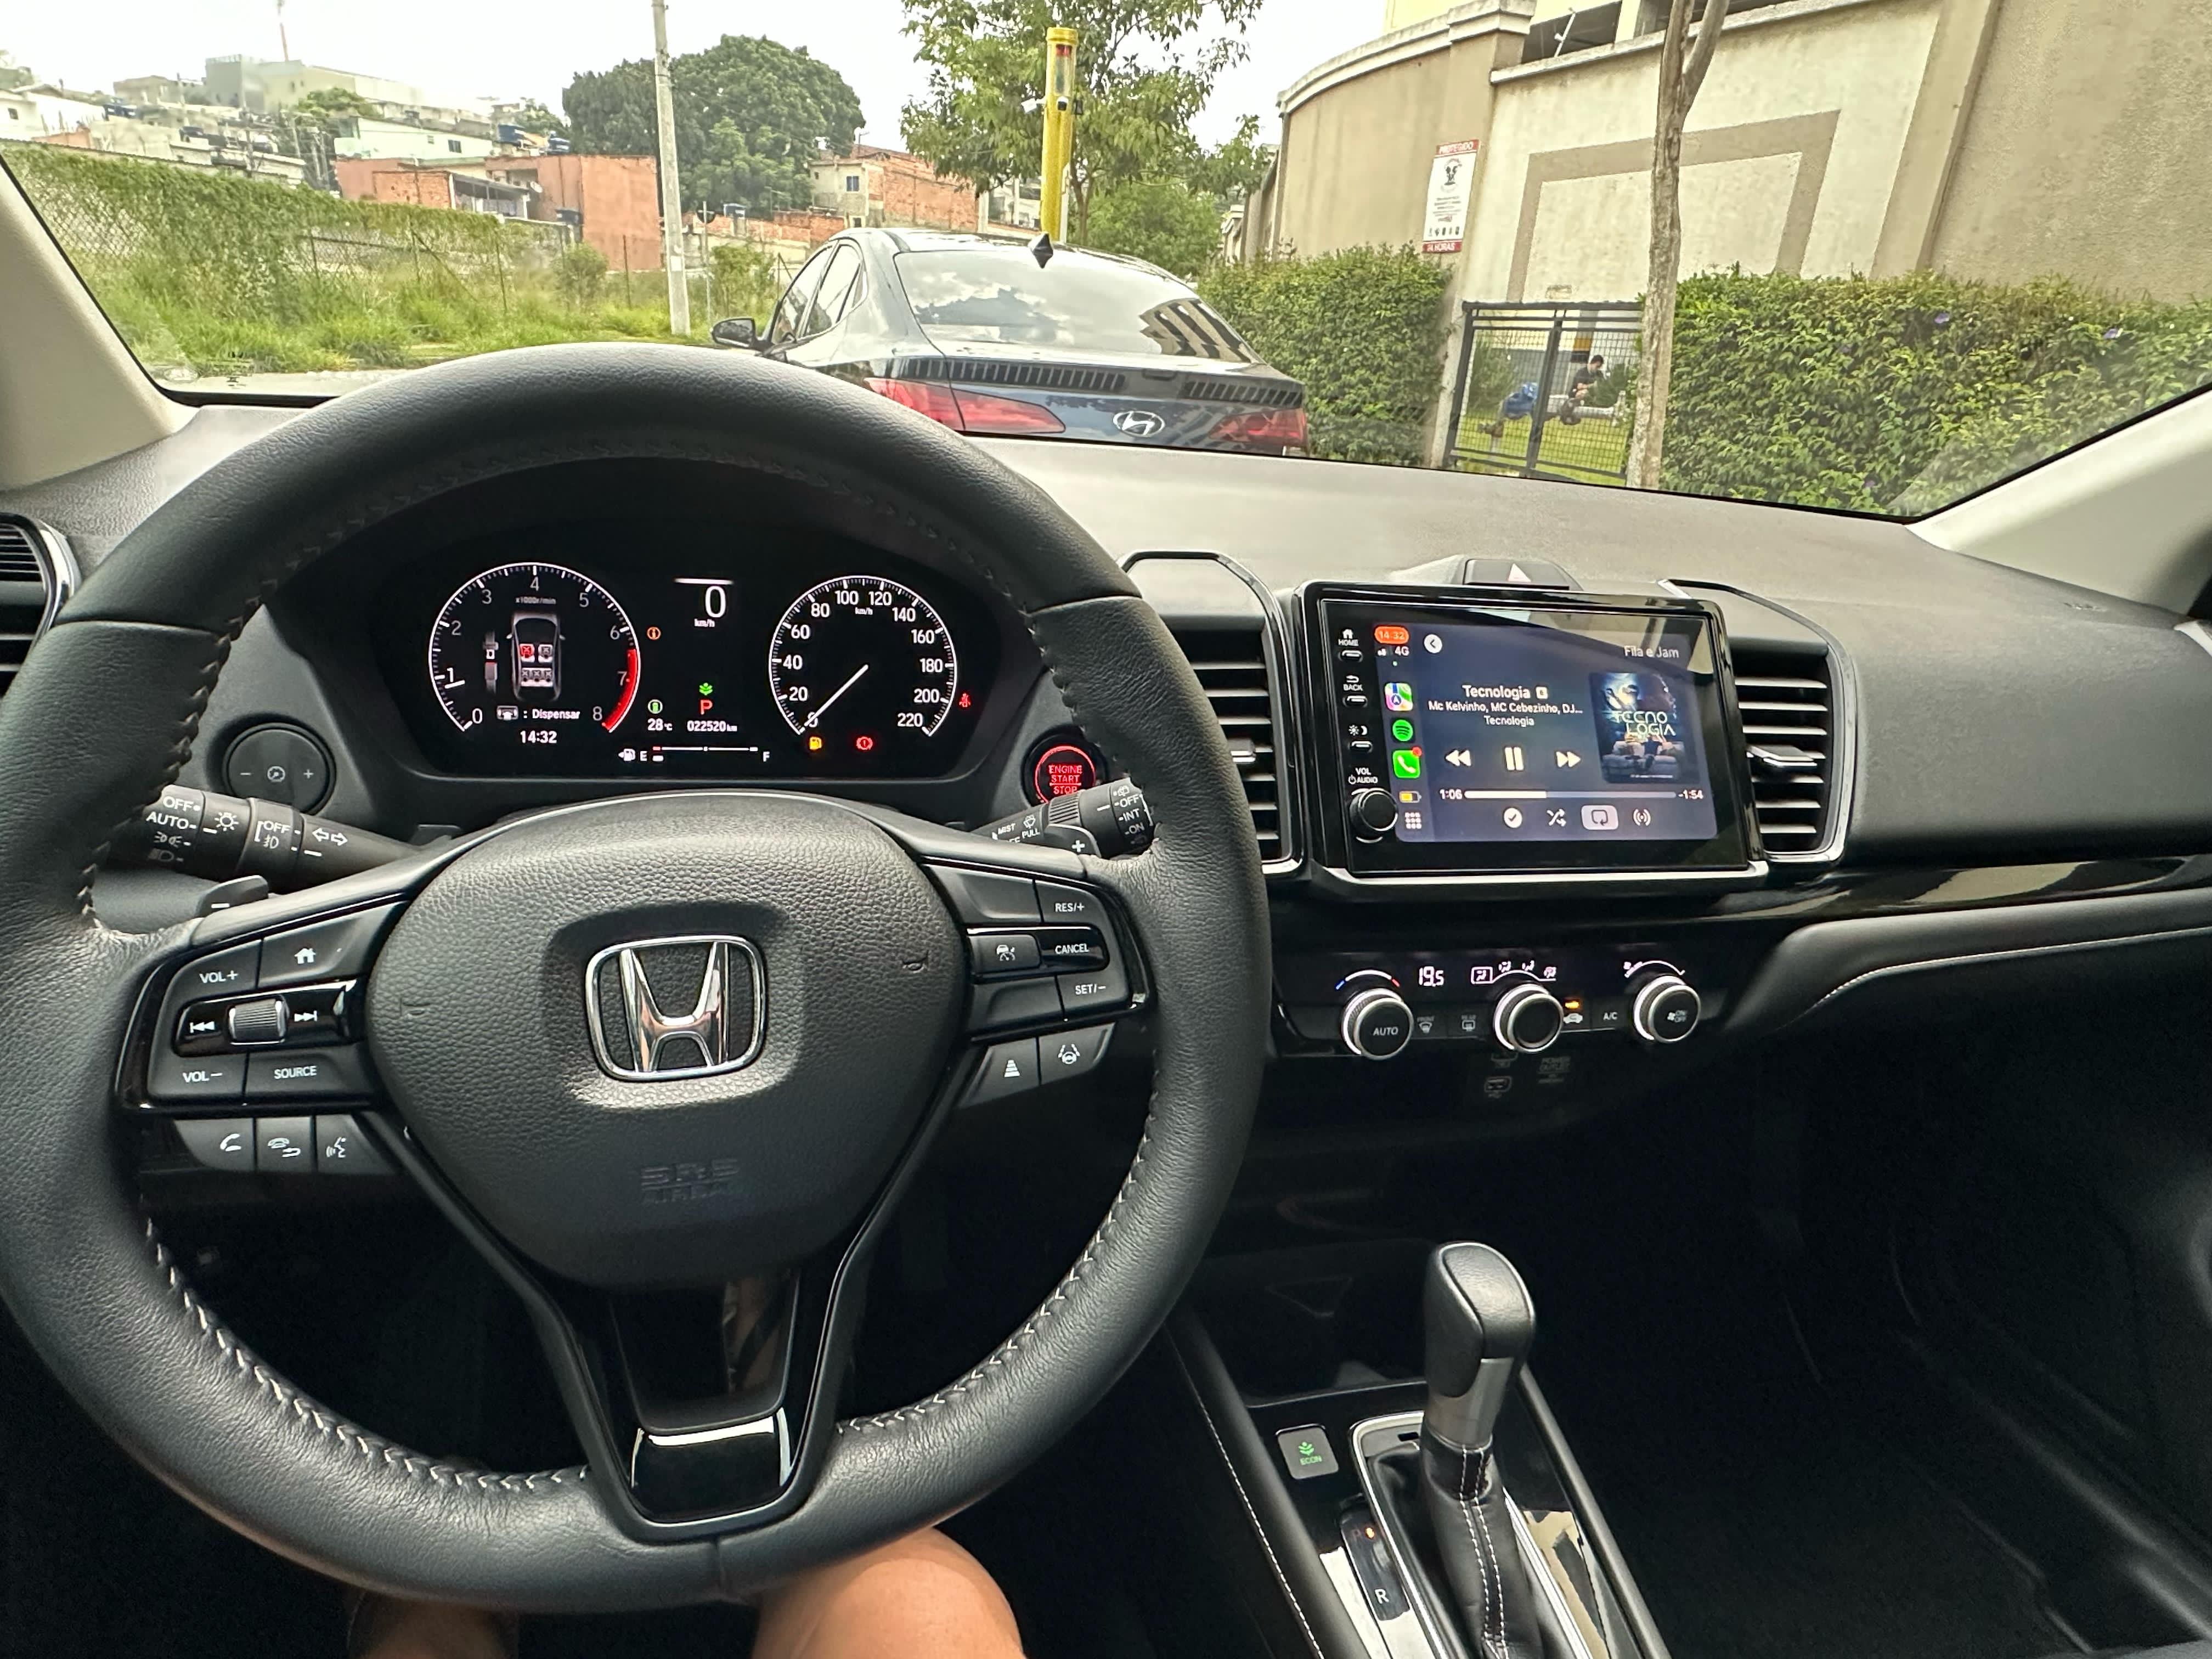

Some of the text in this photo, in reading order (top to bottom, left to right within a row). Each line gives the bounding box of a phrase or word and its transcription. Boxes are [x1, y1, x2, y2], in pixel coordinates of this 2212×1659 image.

[530, 576, 540, 591] 4
[482, 590, 492, 605] 3
[579, 592, 589, 607] 5
[704, 585, 726, 618] 0
[835, 590, 859, 605] 100
[868, 591, 892, 606] 120
[811, 603, 830, 618] 80
[892, 608, 916, 622] 140
[452, 621, 461, 636] 2
[694, 618, 715, 628] km/h
[610, 627, 620, 640] 6
[791, 625, 810, 639] 60
[911, 630, 935, 644] 160
[1395, 646, 1409, 656] 4G
[1624, 646, 1644, 657] Fila
[1656, 647, 1679, 658] Jam
[783, 655, 803, 670] 40
[920, 658, 943, 673] 180
[447, 668, 454, 682] 1
[617, 671, 627, 685] 7
[789, 686, 808, 701] 20
[1343, 684, 1363, 692] BACK
[1462, 685, 1531, 701] Tecnologia
[914, 689, 939, 703] 200
[592, 706, 602, 721] 8
[698, 699, 714, 715] P
[1428, 701, 1443, 712] Mc
[1446, 701, 1489, 713] Kelvinho,
[1491, 702, 1507, 712] MC
[1509, 703, 1560, 714] Cebezinho,
[472, 708, 483, 724] 0
[532, 709, 580, 720] Dispensar
[898, 713, 923, 727] 220
[1484, 715, 1534, 727] Tecnologia
[520, 730, 557, 743] 14:32
[640, 751, 647, 761] E
[763, 751, 770, 761] F
[1048, 765, 1082, 774] ENGINE
[1051, 775, 1080, 783] START
[1053, 785, 1077, 794] STOP
[163, 795, 194, 812] OFF
[1120, 794, 1140, 808] OFF
[146, 812, 190, 830] AUTO
[1122, 808, 1141, 822] INT
[263, 820, 291, 833] OFF
[1022, 828, 1041, 839] PULL
[1129, 823, 1145, 834] ON
[1055, 902, 1085, 913] RES/+
[1054, 944, 1089, 955] CANCEL
[1603, 1012, 1618, 1020] A/C
[1373, 1026, 1398, 1036] AUTO
[274, 1066, 317, 1080] SOURCE
[1300, 1455, 1322, 1465] ECON
[1374, 1588, 1389, 1604] R
